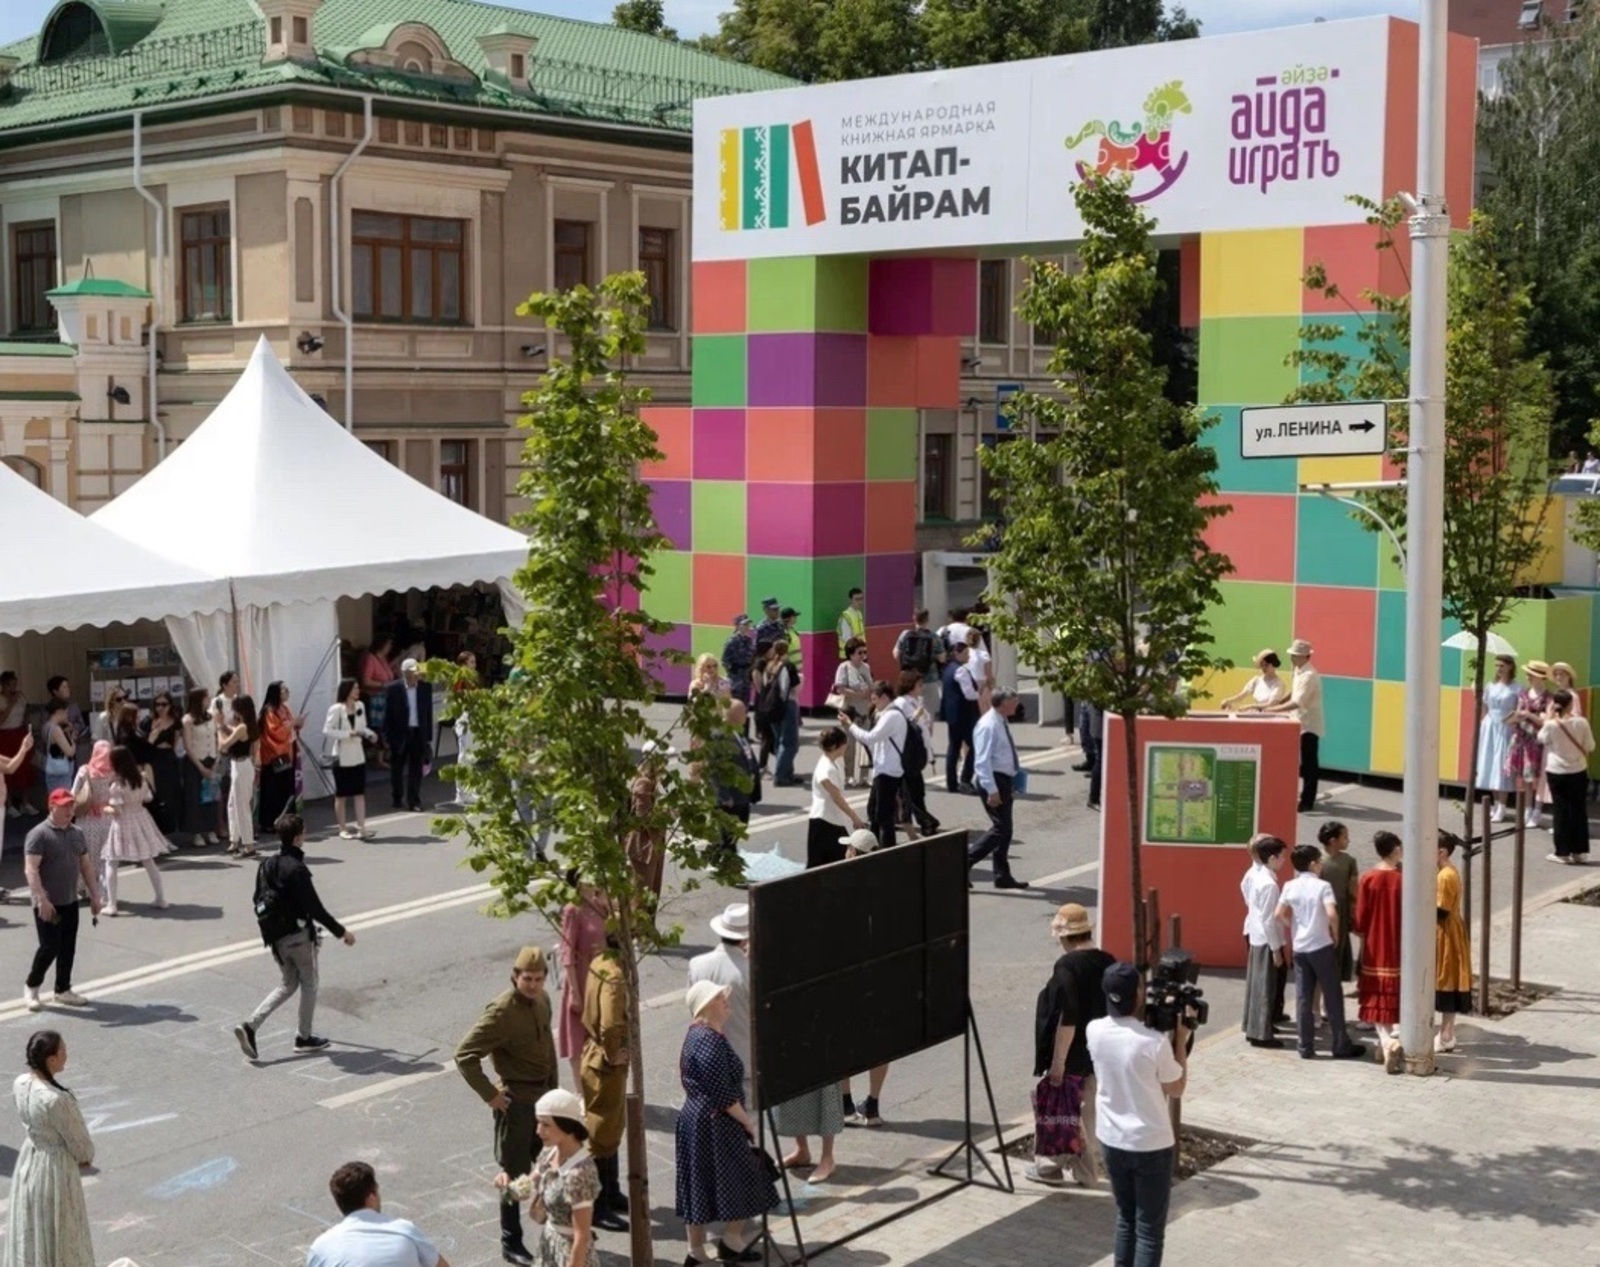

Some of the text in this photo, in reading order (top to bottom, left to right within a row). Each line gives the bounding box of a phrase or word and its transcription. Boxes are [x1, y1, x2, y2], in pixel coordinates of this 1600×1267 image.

[841, 101, 996, 128] МЕЖДУНАРОДНАЯ
[841, 119, 996, 146] КНИЖНАЯ ЯРМАРКА
[840, 147, 970, 184] КИТАП-
[1229, 139, 1341, 194] играть
[840, 185, 991, 226] БАЙРАМ
